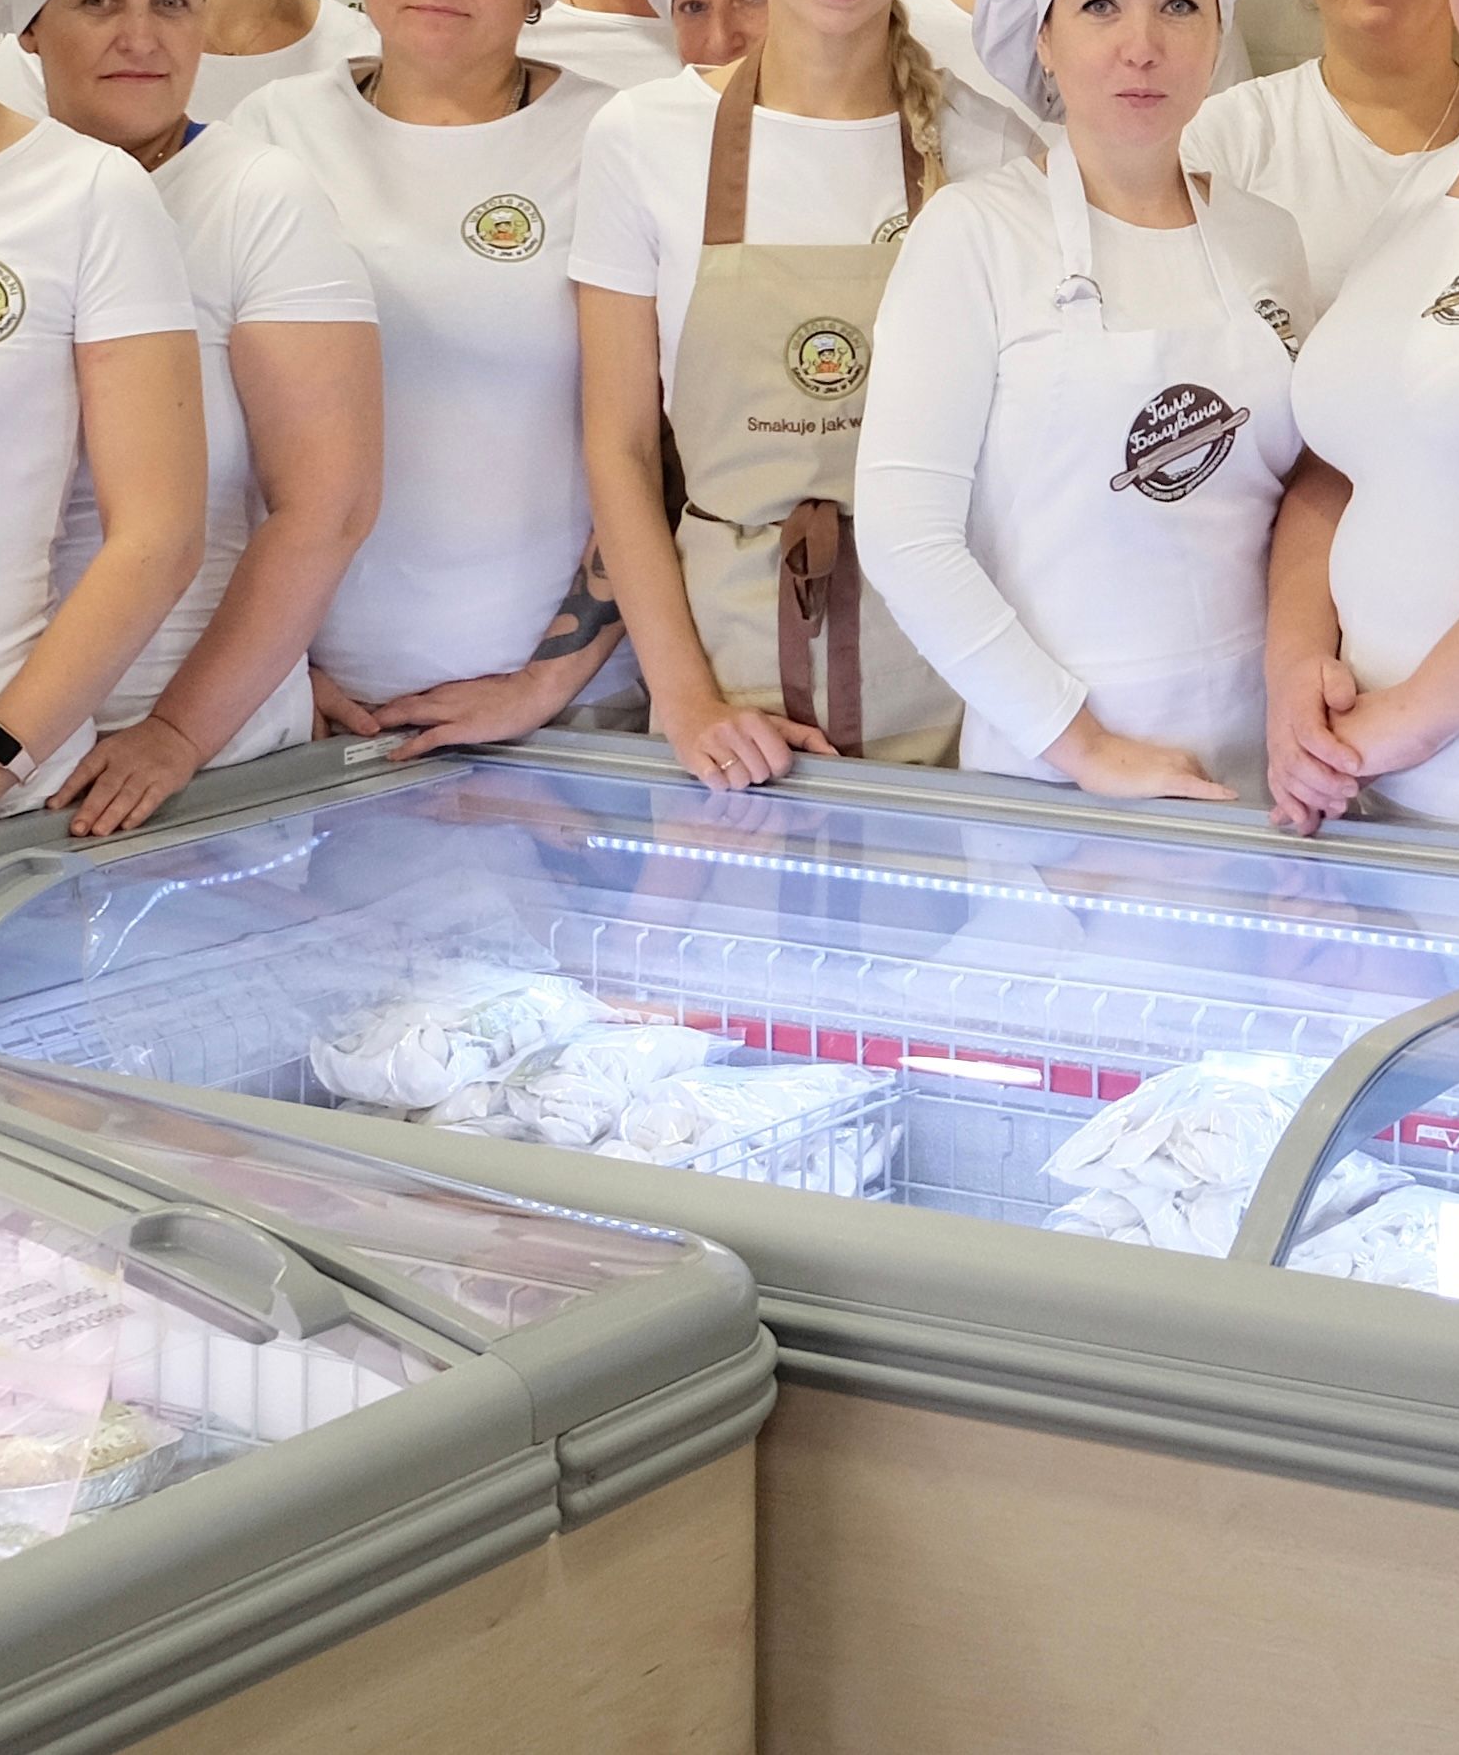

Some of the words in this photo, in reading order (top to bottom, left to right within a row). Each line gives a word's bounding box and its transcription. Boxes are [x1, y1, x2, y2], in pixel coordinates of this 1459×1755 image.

[747, 416, 817, 436] Smakuje
[821, 416, 847, 435] jak
[1145, 390, 1196, 426] Галя
[1129, 399, 1223, 454] Балувана
